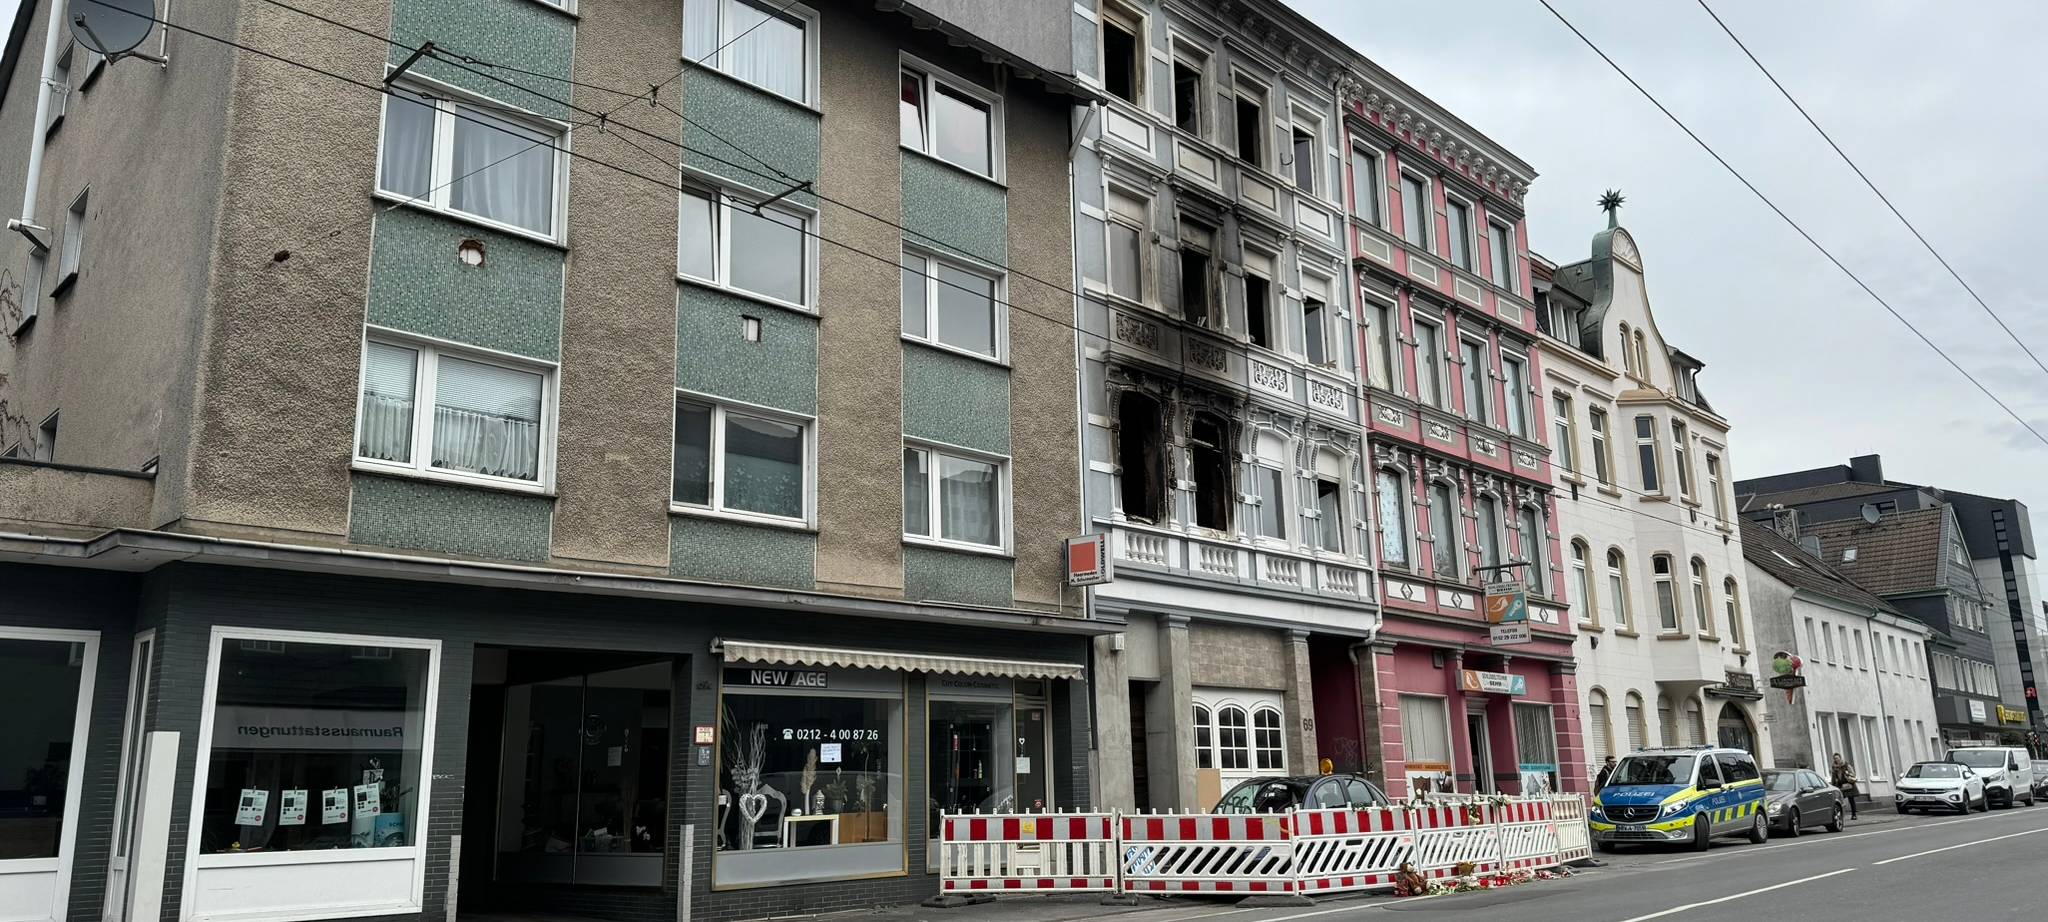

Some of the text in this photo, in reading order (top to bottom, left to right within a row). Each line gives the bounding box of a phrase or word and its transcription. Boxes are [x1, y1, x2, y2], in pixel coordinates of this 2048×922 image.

[751, 670, 826, 687] NEW AGE
[1303, 718, 1313, 731] 69
[797, 729, 821, 740] 0212
[830, 729, 836, 740] 4
[839, 729, 851, 740] 00
[853, 729, 864, 740] 87
[867, 729, 878, 740] 26
